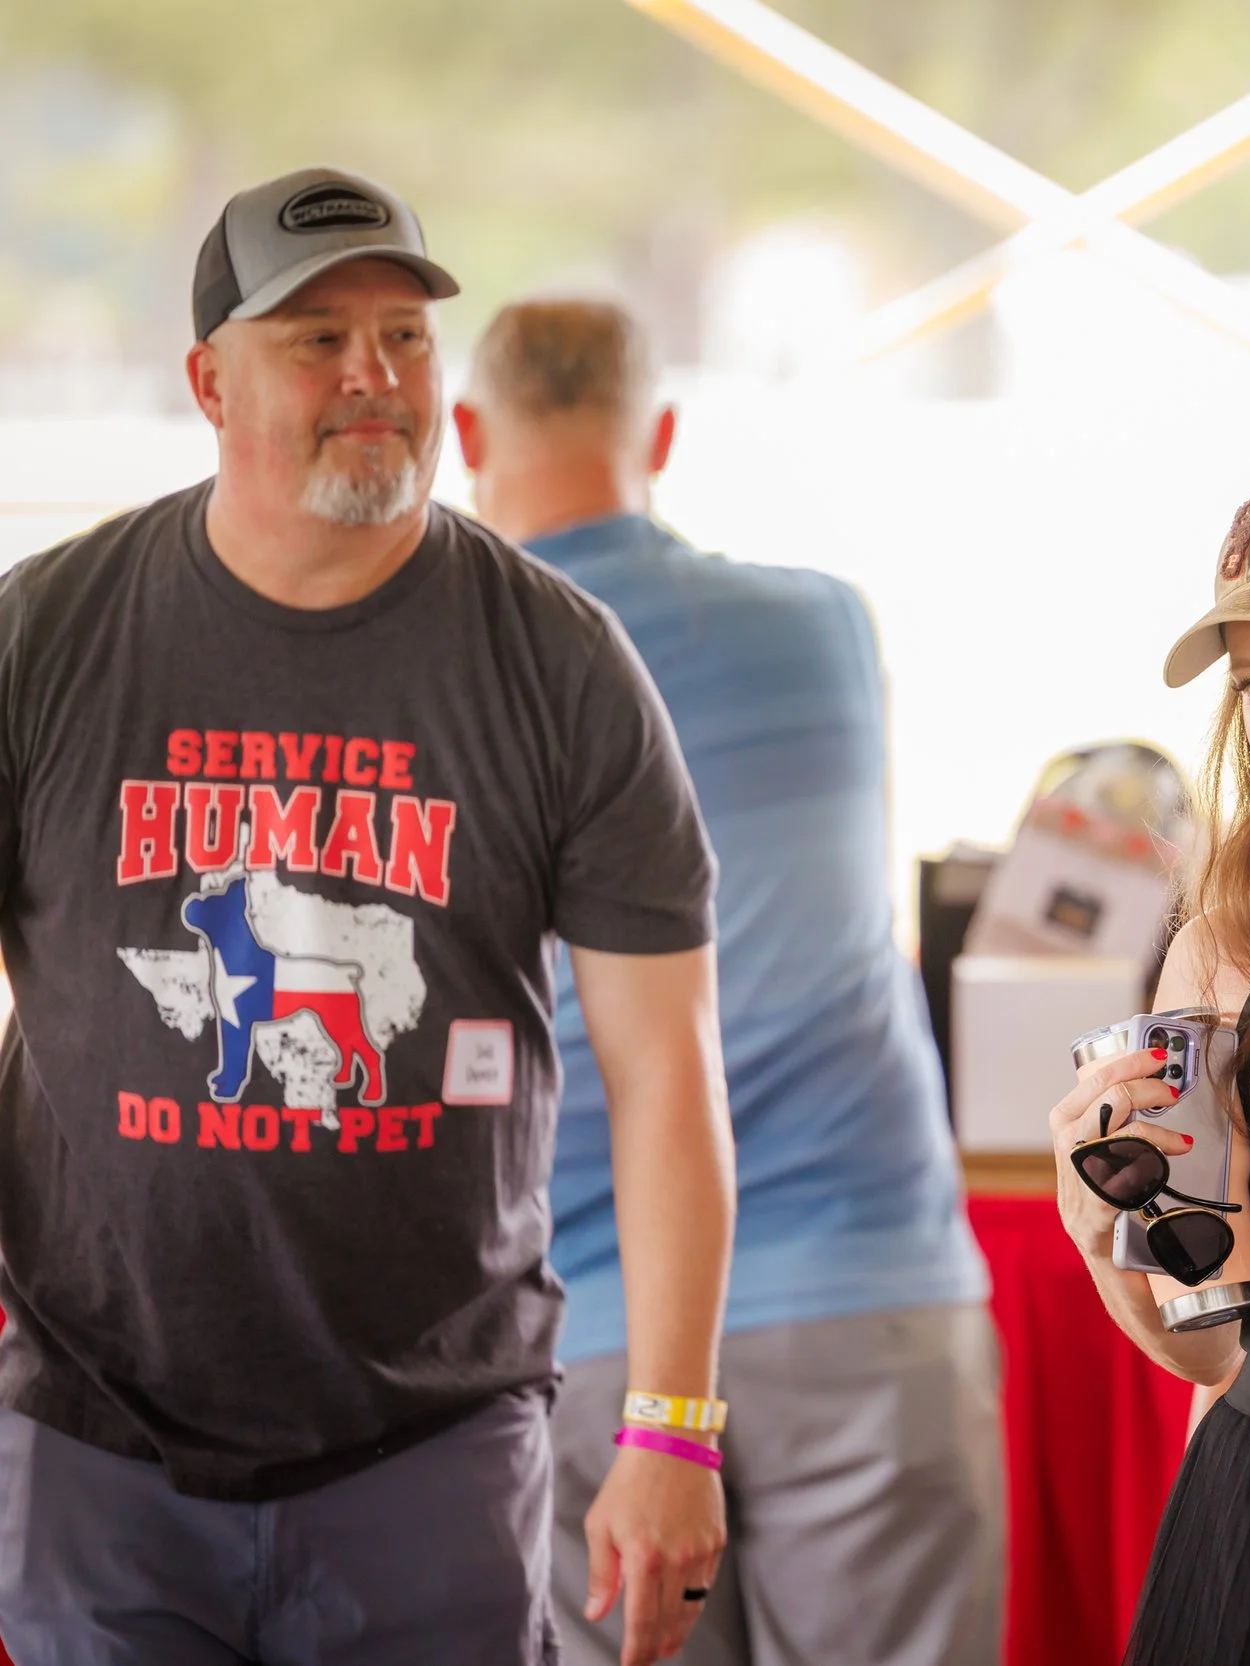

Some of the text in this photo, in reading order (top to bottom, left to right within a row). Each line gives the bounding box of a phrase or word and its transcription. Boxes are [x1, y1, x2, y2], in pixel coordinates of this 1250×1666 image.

[166, 729, 416, 790] SERVICE
[117, 779, 457, 907] HUMAN
[117, 1091, 443, 1154] DO NOT PET
